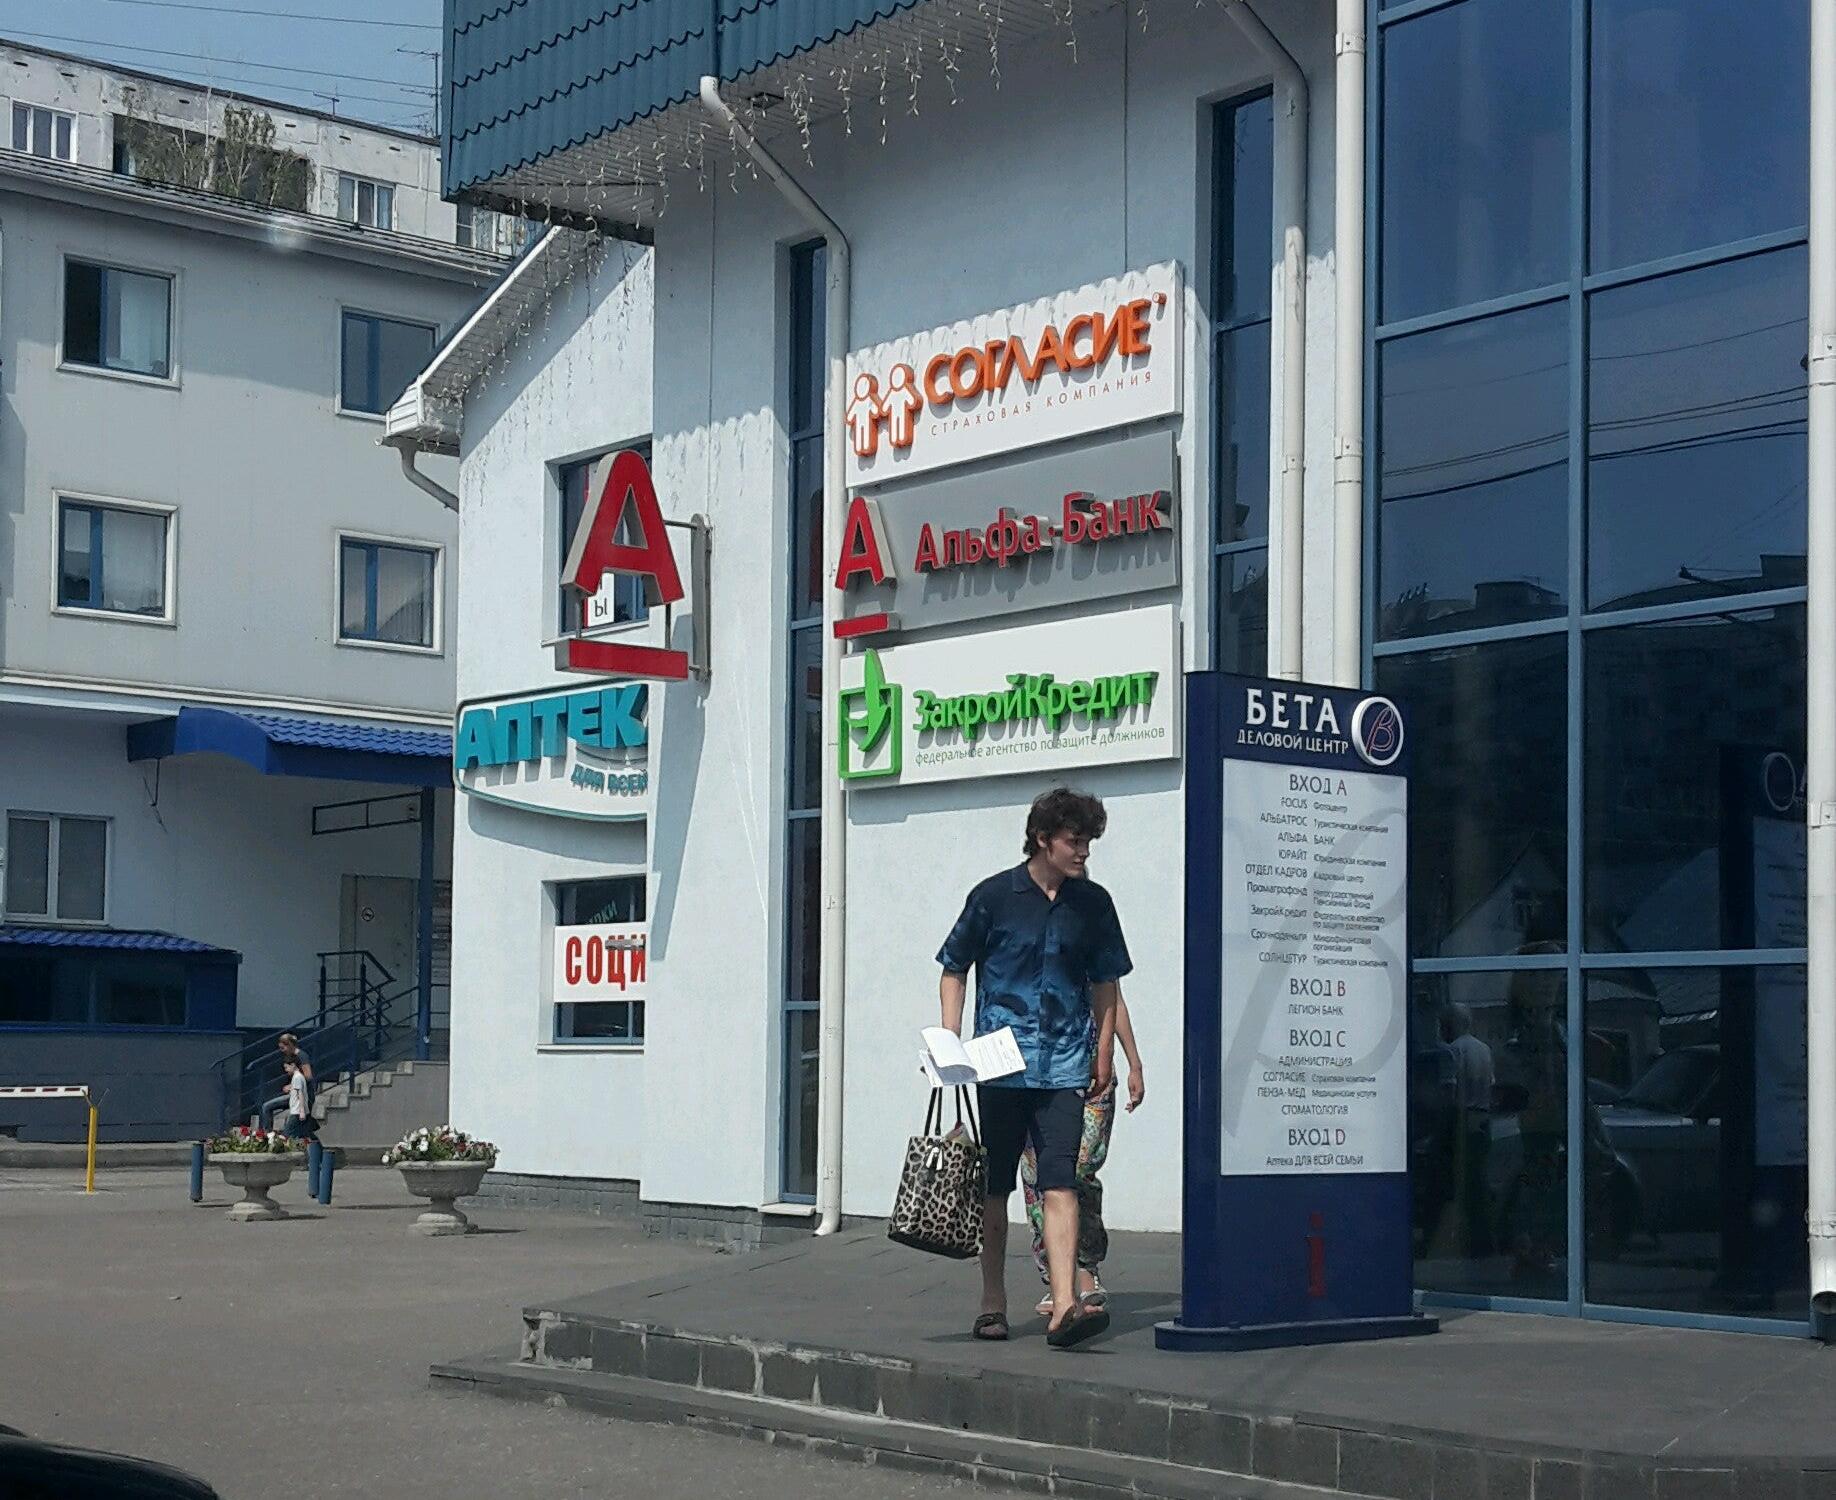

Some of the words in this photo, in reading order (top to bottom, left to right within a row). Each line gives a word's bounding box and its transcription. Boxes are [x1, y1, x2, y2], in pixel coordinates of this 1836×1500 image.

[924, 298, 1151, 405] СОГЛАСИЕ
[931, 401, 1032, 437] СТРАХОВАЯ
[1046, 371, 1153, 407] КОМПАНИЯ
[912, 671, 1159, 742] ЗакройКредит
[1245, 688, 1340, 735] БЕТА
[915, 748, 983, 768] федеральное
[985, 740, 1037, 758] агентство
[1040, 739, 1053, 751] по
[1054, 734, 1097, 750] защите
[1099, 727, 1166, 746] должников
[1236, 728, 1302, 751] ДЕЛОВОЙ
[1306, 736, 1350, 755] ЦЕНТР
[1288, 773, 1332, 796] ВХОД
[1280, 797, 1308, 810] FOCUS
[1259, 812, 1308, 828] АЛЬБАТРОС
[1278, 831, 1308, 844] АЛЬФА
[1313, 834, 1336, 846] БАНК
[1245, 863, 1274, 877] ОТДЕЛ
[1275, 866, 1308, 879] КАДРОВ
[1288, 977, 1332, 997] ВХОД
[1287, 1003, 1321, 1016] ЛЕГИОН
[1321, 1005, 1344, 1017] БАНК
[1288, 1028, 1332, 1048] ВХОД
[1277, 1055, 1354, 1068] АДМИНИСТРАЦИЯ
[1263, 1071, 1307, 1084] СОГЛАСИЕ
[1280, 1103, 1350, 1117] СТОМАТОЛОГИЯ
[1288, 1128, 1331, 1147] ВХОД
[1335, 1128, 1347, 1147] D
[1265, 1156, 1294, 1167] Аптека
[1294, 1155, 1313, 1168] ДЛЯ
[1313, 1152, 1335, 1168] ВСЕЙ
[1335, 1154, 1365, 1168] СЕМЬИ
